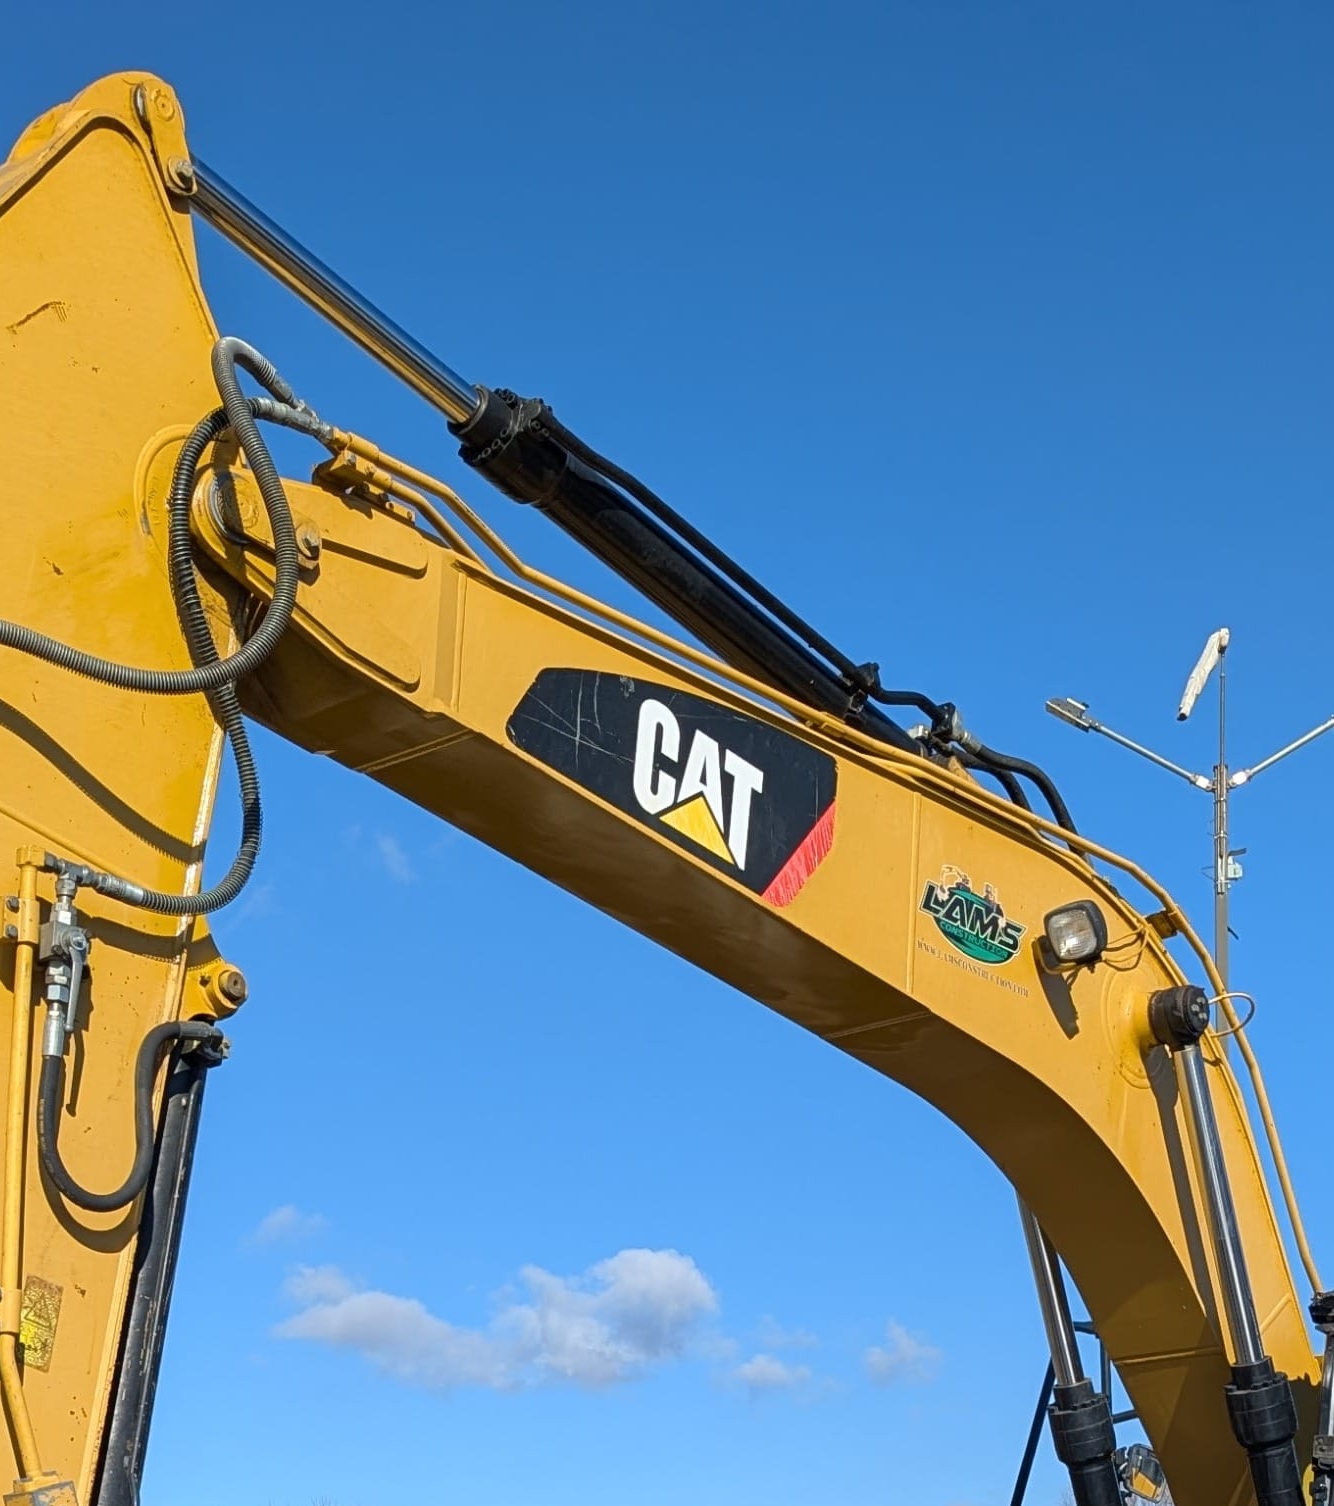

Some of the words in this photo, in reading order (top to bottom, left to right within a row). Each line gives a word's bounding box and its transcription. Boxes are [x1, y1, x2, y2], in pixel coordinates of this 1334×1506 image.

[633, 698, 764, 871] CAT
[920, 882, 1024, 954] LAMS
[939, 921, 1009, 958] CONSTRUCTION
